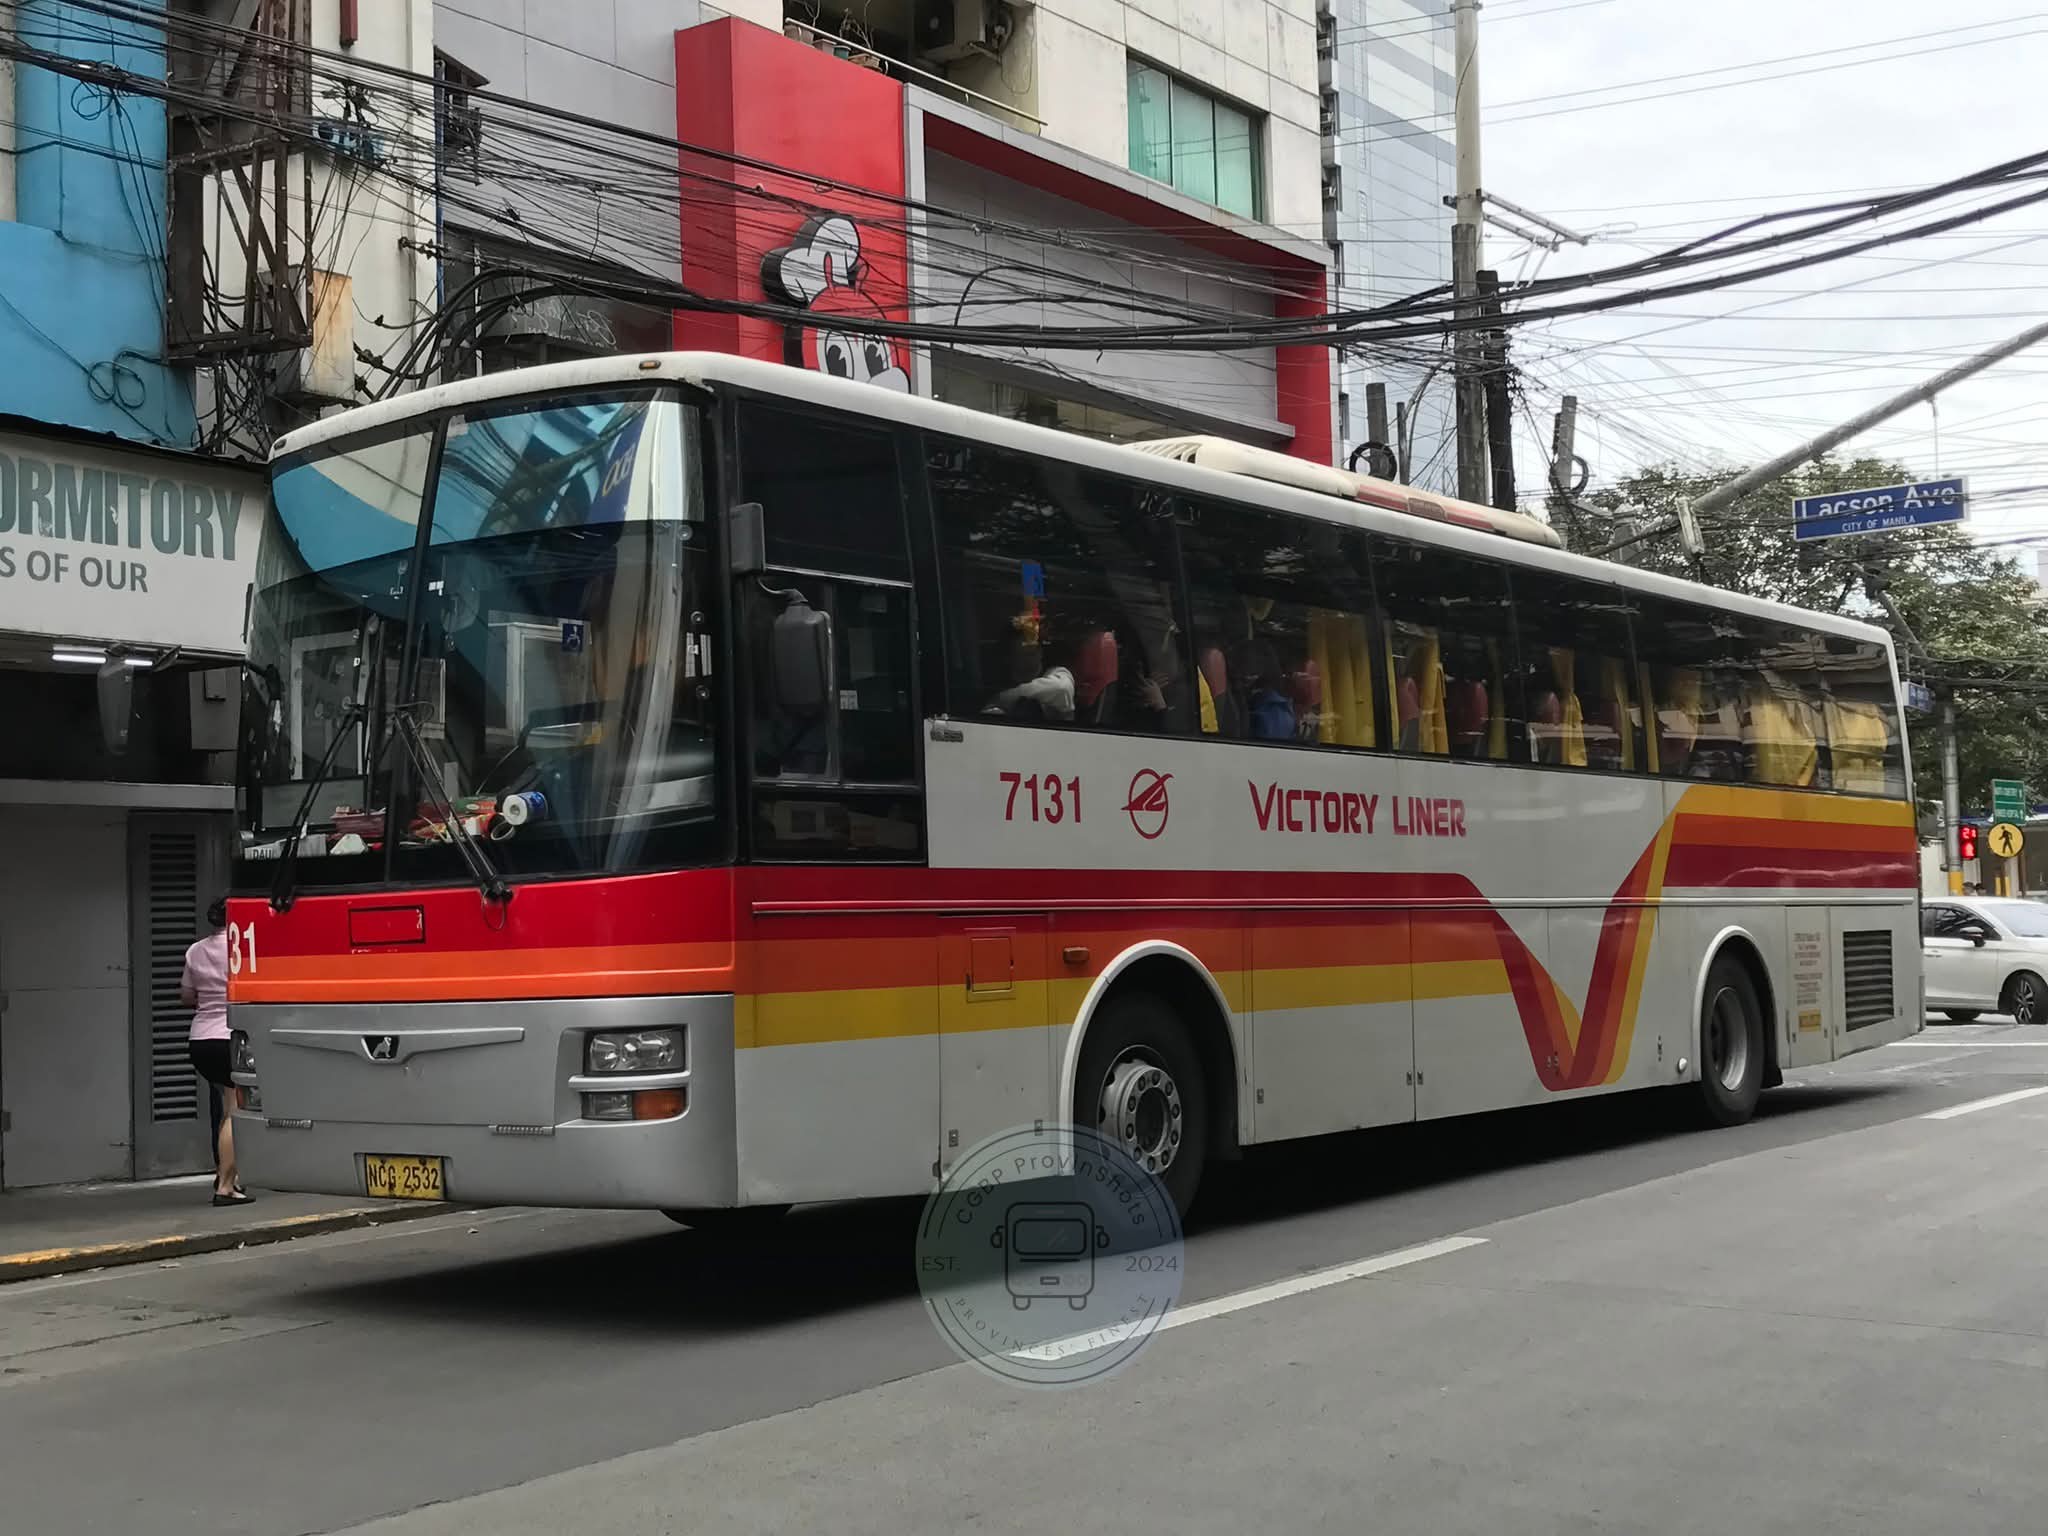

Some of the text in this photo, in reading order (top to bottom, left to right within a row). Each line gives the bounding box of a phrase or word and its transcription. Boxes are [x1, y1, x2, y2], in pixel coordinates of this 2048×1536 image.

[1801, 485, 1956, 520] Lacson Ave
[1841, 514, 1917, 533] CITY OF MANILA
[27, 550, 69, 583] OF
[80, 557, 148, 593] OUR
[999, 771, 1082, 824] 7131
[1248, 779, 1467, 837] VICTORY LINER
[403, 1165, 440, 1190] 2532
